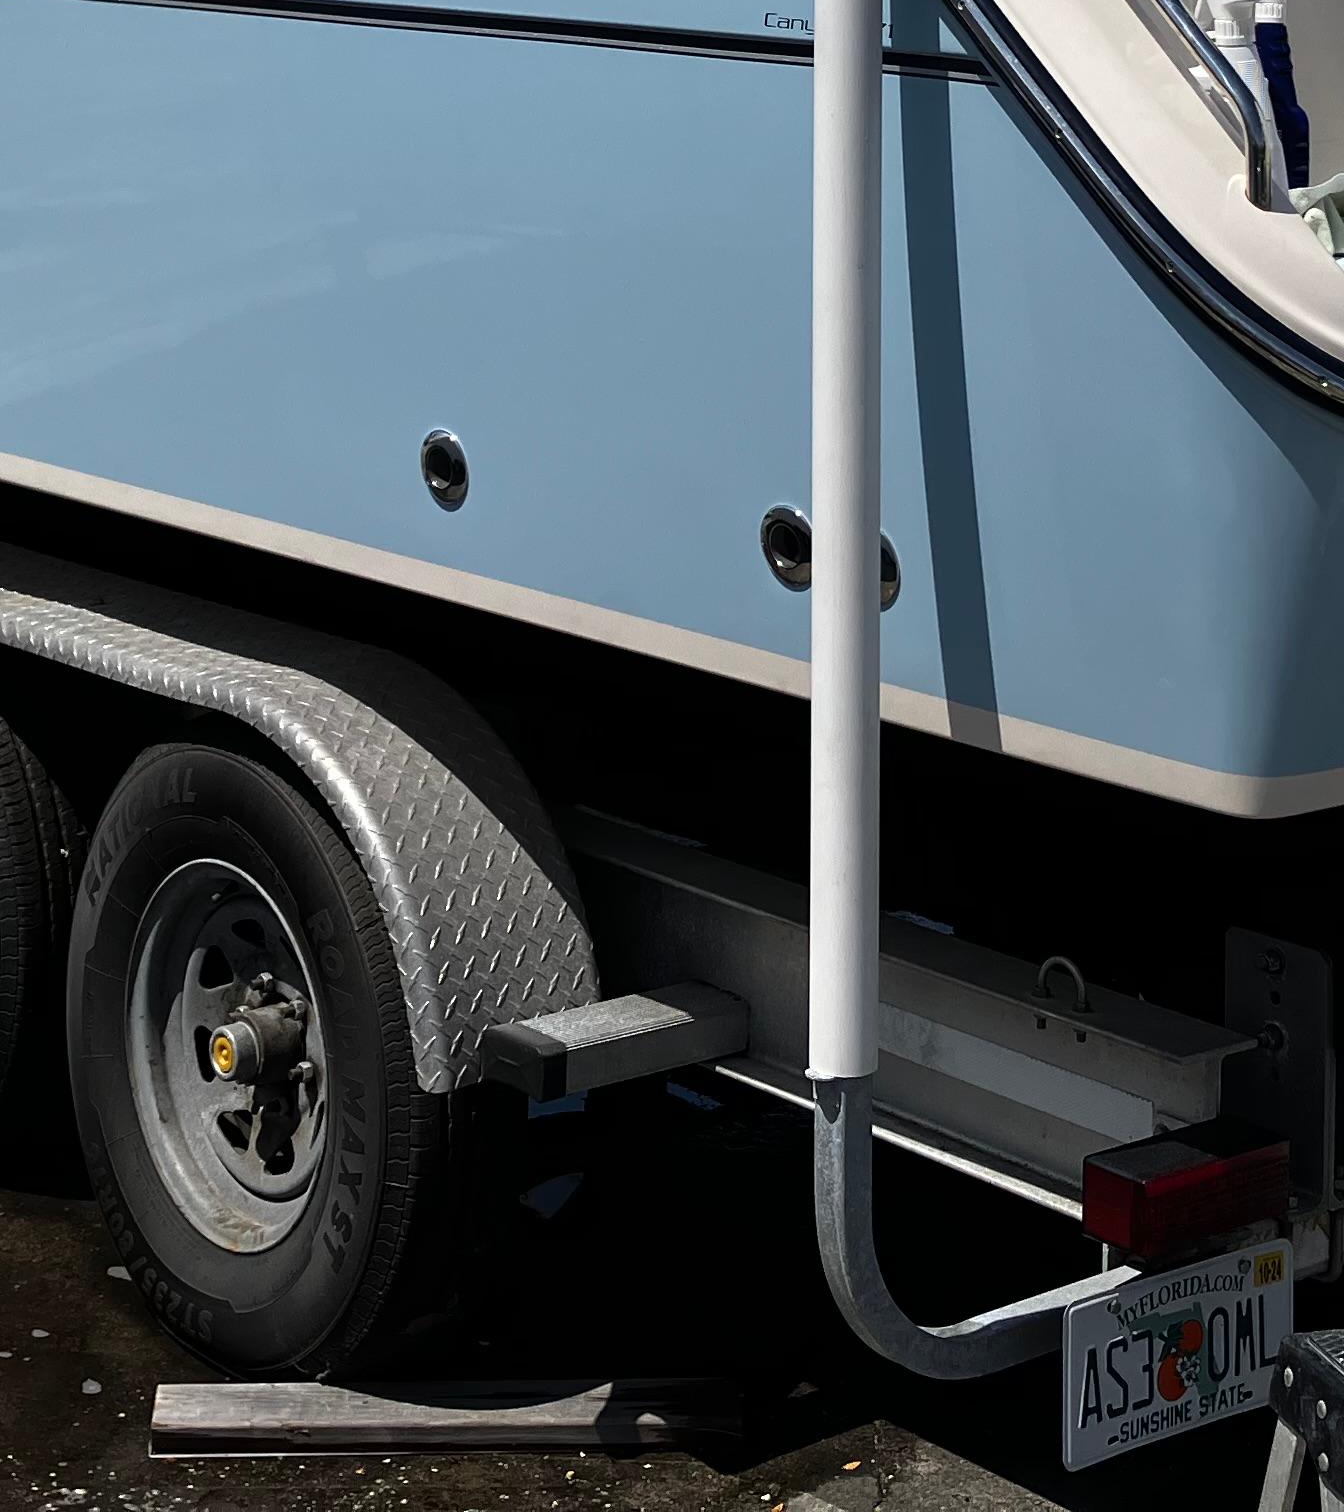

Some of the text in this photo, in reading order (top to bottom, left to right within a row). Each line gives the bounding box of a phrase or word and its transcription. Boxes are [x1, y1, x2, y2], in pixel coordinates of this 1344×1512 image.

[764, 12, 814, 35] Cany
[1259, 1258, 1281, 1284] 10-24
[1116, 1274, 1245, 1331] MYFLORIDA.COM
[1119, 1382, 1245, 1443] SUNSHINE STATE
